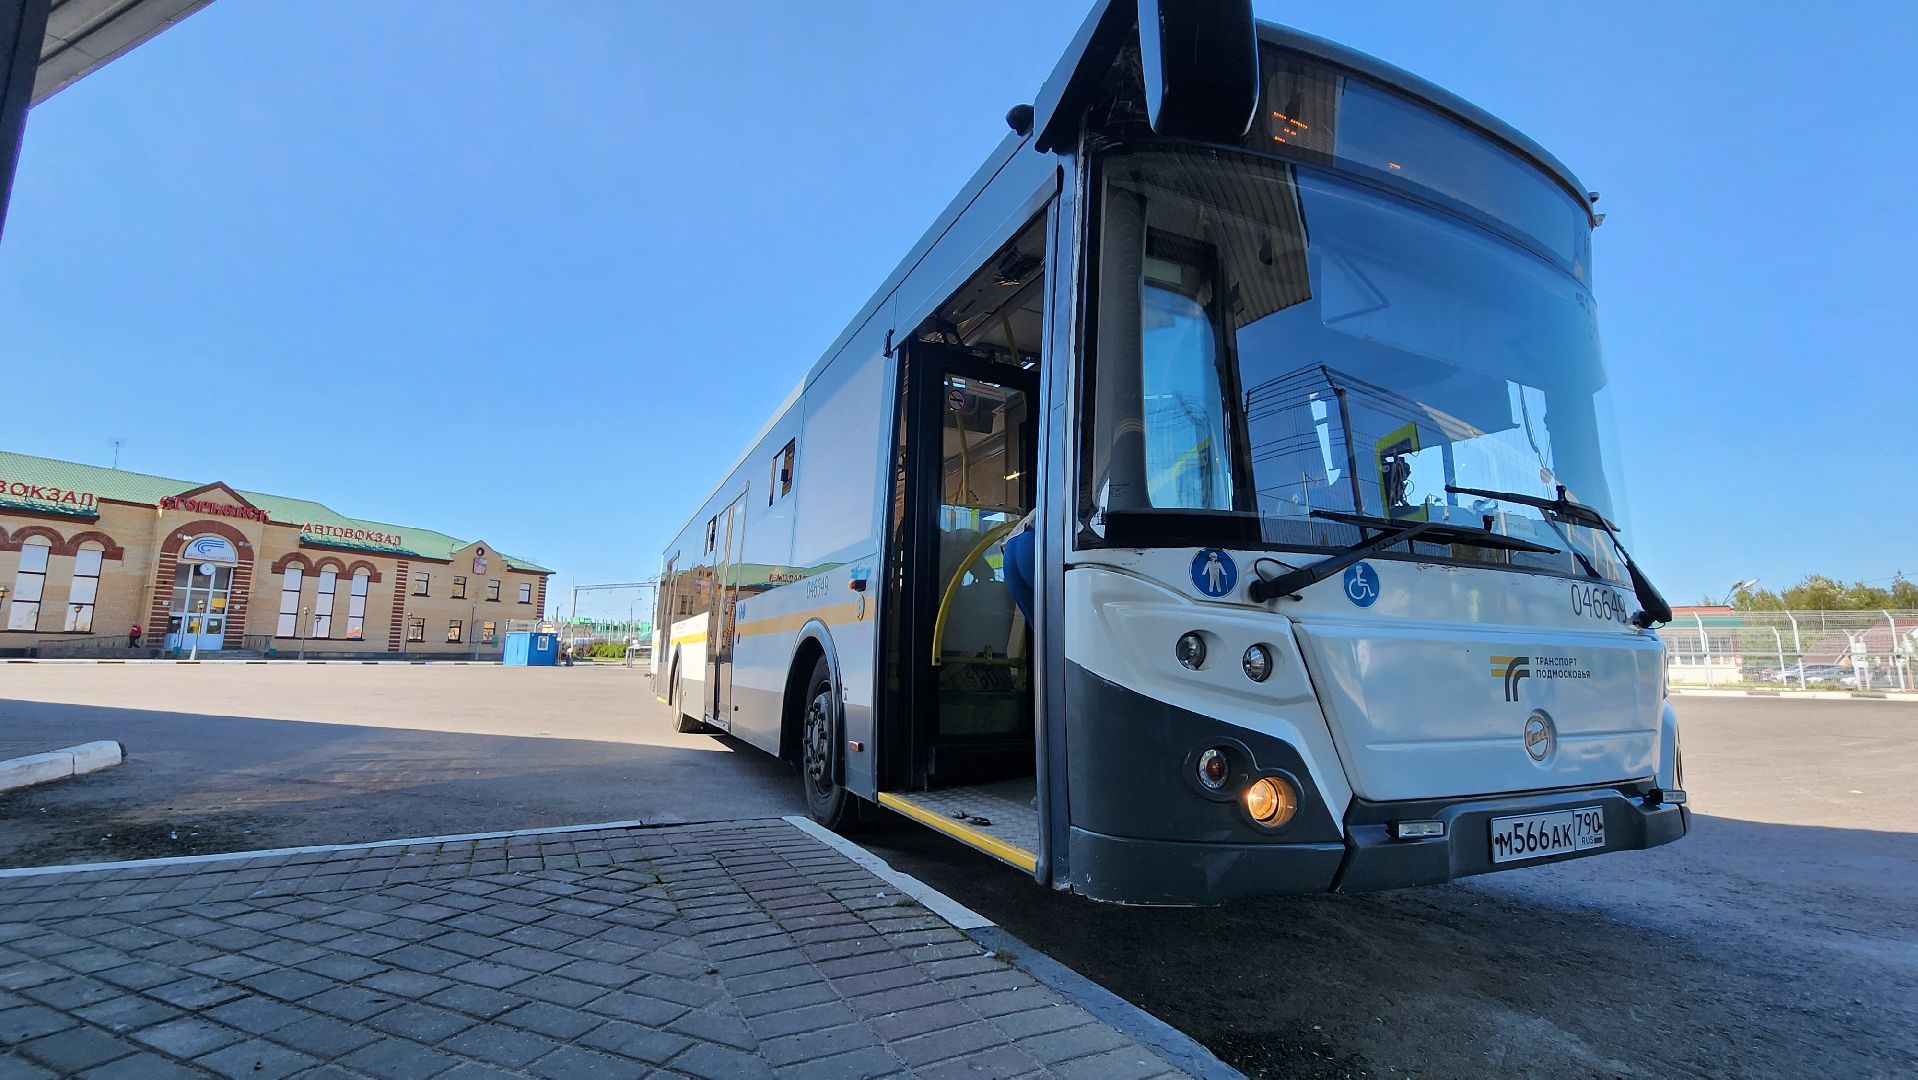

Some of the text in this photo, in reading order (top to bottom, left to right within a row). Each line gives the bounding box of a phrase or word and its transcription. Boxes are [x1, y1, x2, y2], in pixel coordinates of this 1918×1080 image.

[301, 522, 402, 546] АВТОВОКЗАЛ
[1571, 583, 1627, 624] 046649
[1535, 656, 1577, 667] ТРАНСПОРТ
[1536, 669, 1591, 680] ПОДМОСКОВЬЯ
[1575, 811, 1601, 836] 790
[1581, 836, 1594, 845] RUS
